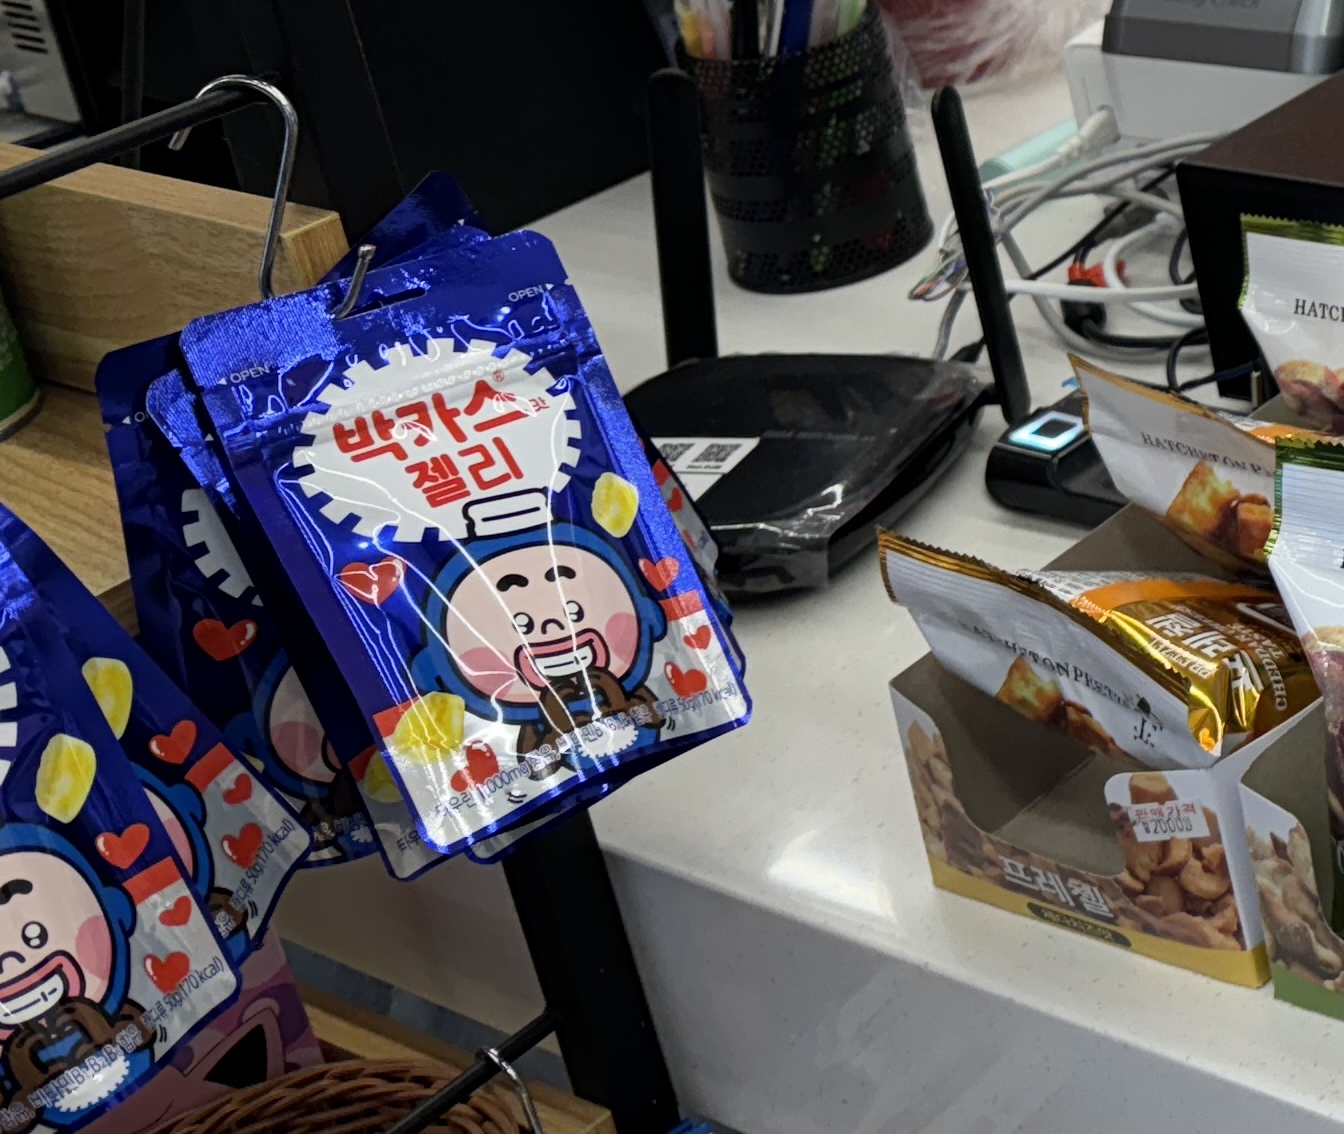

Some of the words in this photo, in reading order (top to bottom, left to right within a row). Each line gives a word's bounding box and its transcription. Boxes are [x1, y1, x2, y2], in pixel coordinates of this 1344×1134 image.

[509, 285, 543, 303] OPEN
[230, 364, 268, 384] OPEN
[332, 379, 530, 464] 박카스
[406, 435, 524, 510] 젤리
